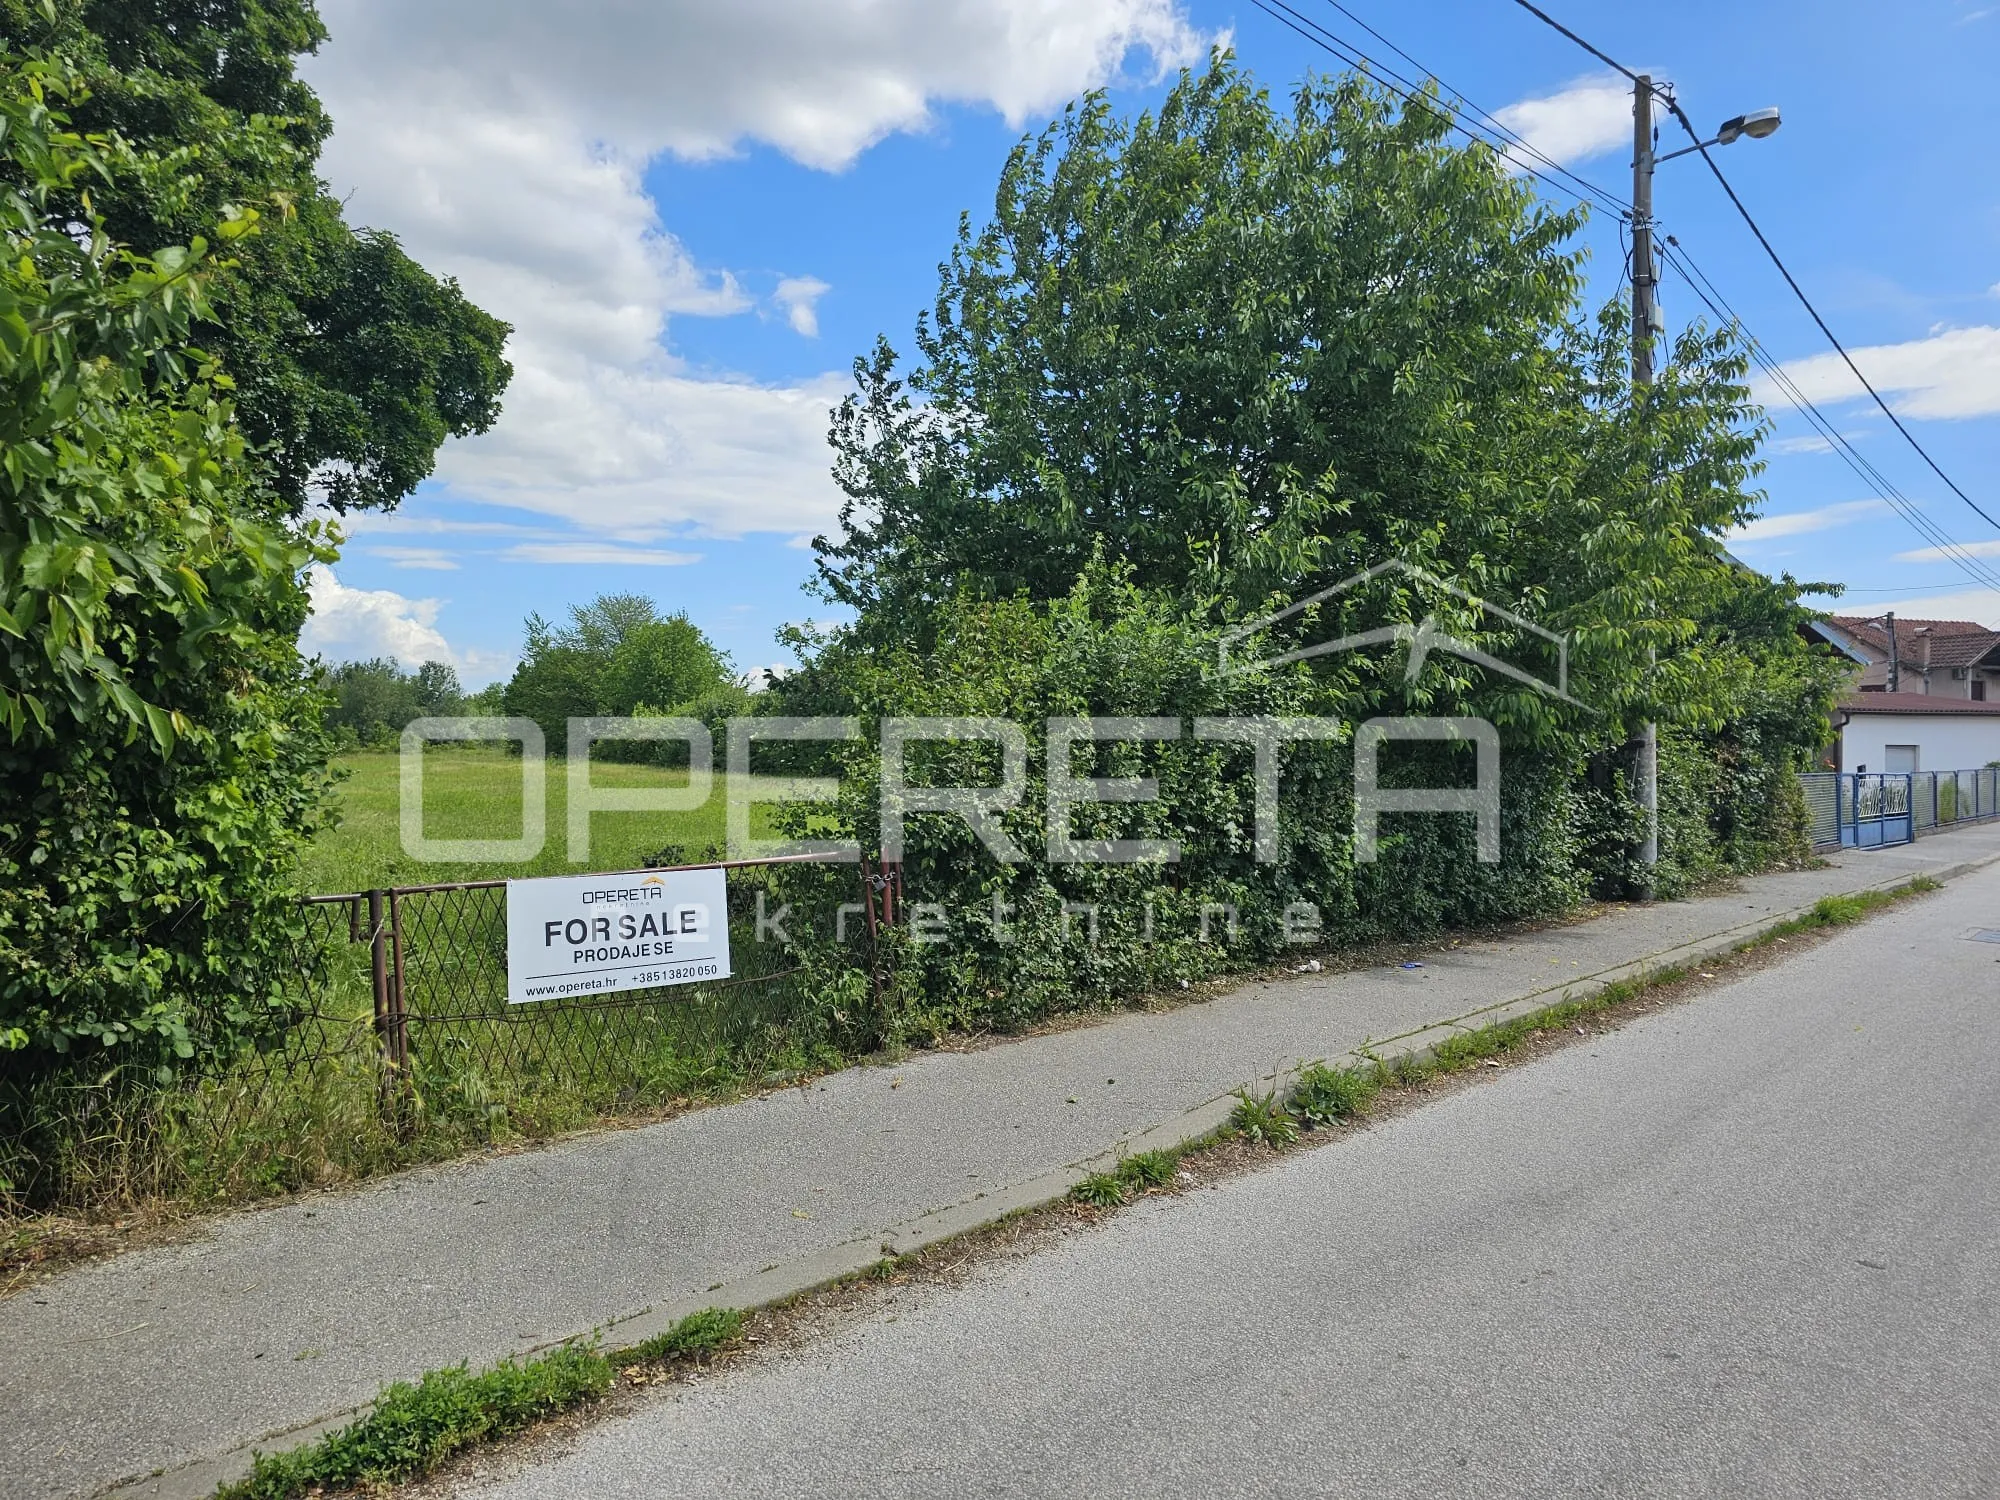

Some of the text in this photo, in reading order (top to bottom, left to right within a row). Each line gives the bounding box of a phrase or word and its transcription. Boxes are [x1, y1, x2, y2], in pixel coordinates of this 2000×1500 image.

[582, 887, 662, 904] OPERETA
[545, 909, 697, 946] FOR SALE
[573, 941, 674, 964] PRODAJE SE
[525, 977, 618, 997] www.opereta.hr
